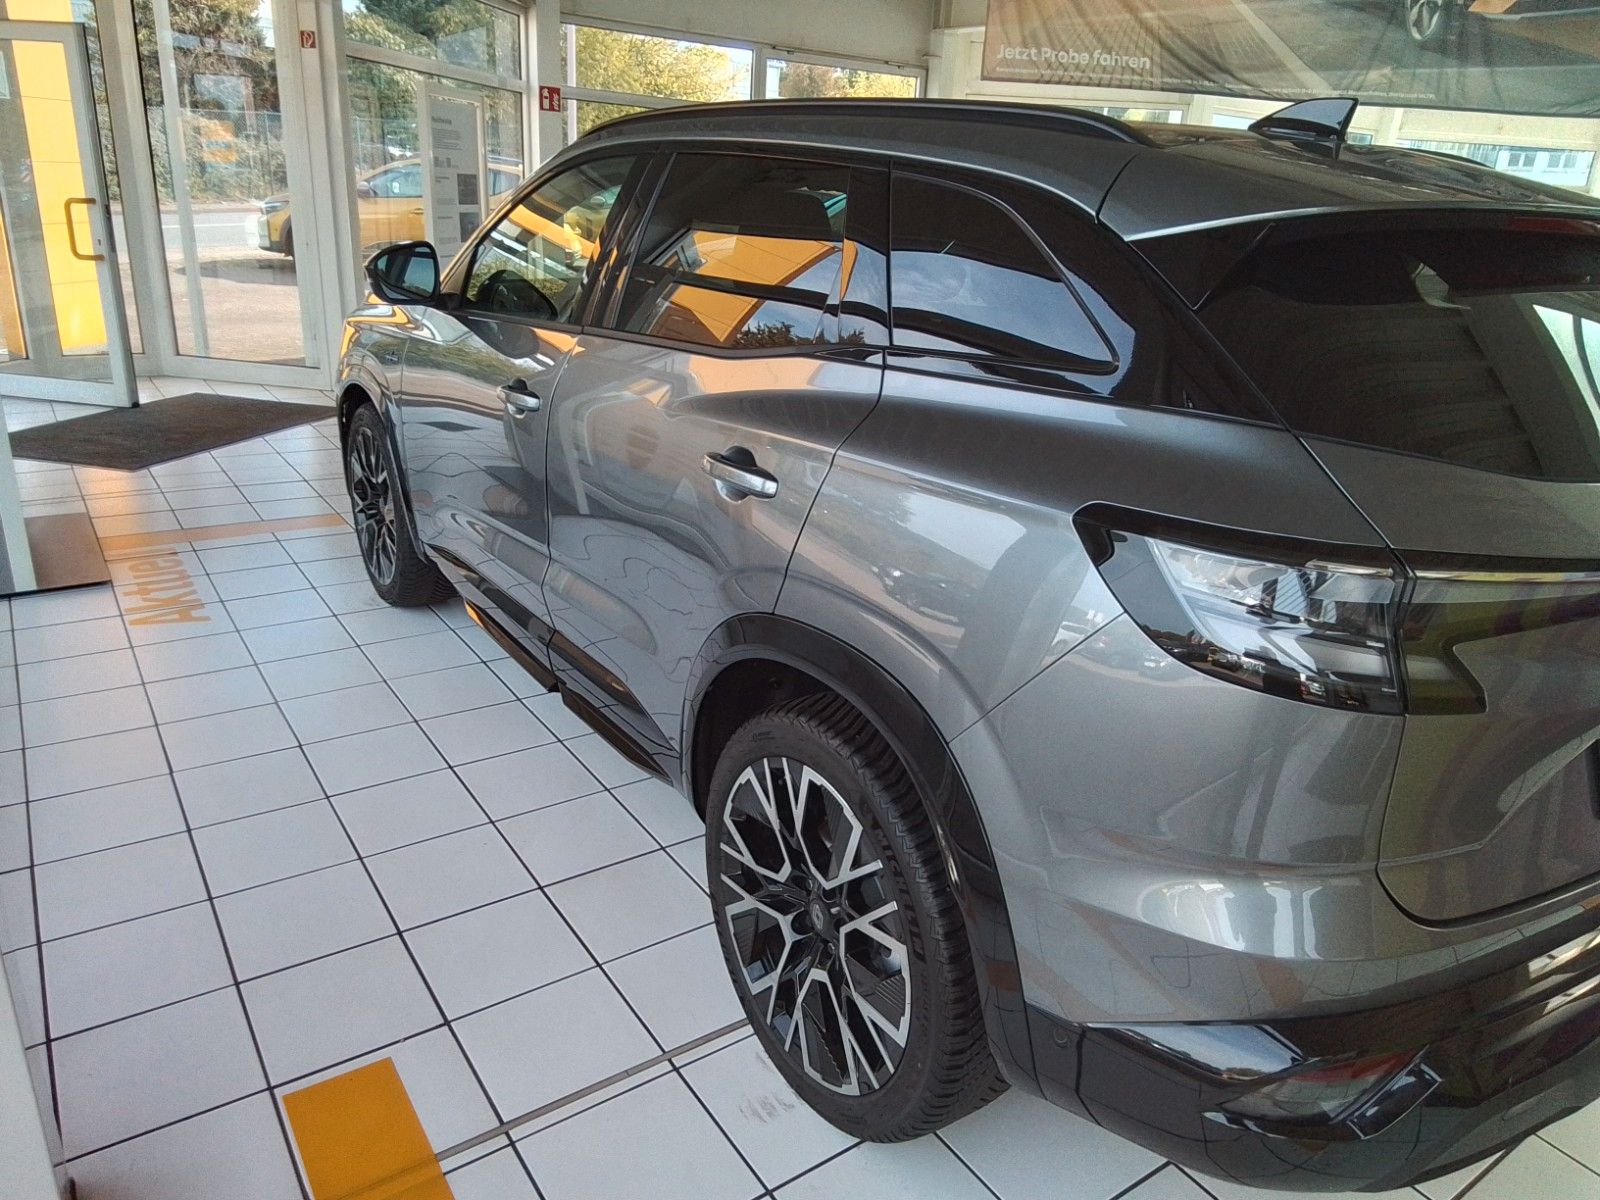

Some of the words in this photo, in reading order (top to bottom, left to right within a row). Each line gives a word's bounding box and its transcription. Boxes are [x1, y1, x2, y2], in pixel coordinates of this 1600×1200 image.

[996, 44, 1038, 61] Jetzt
[1041, 48, 1089, 65] Probe
[1093, 49, 1152, 70] fahren
